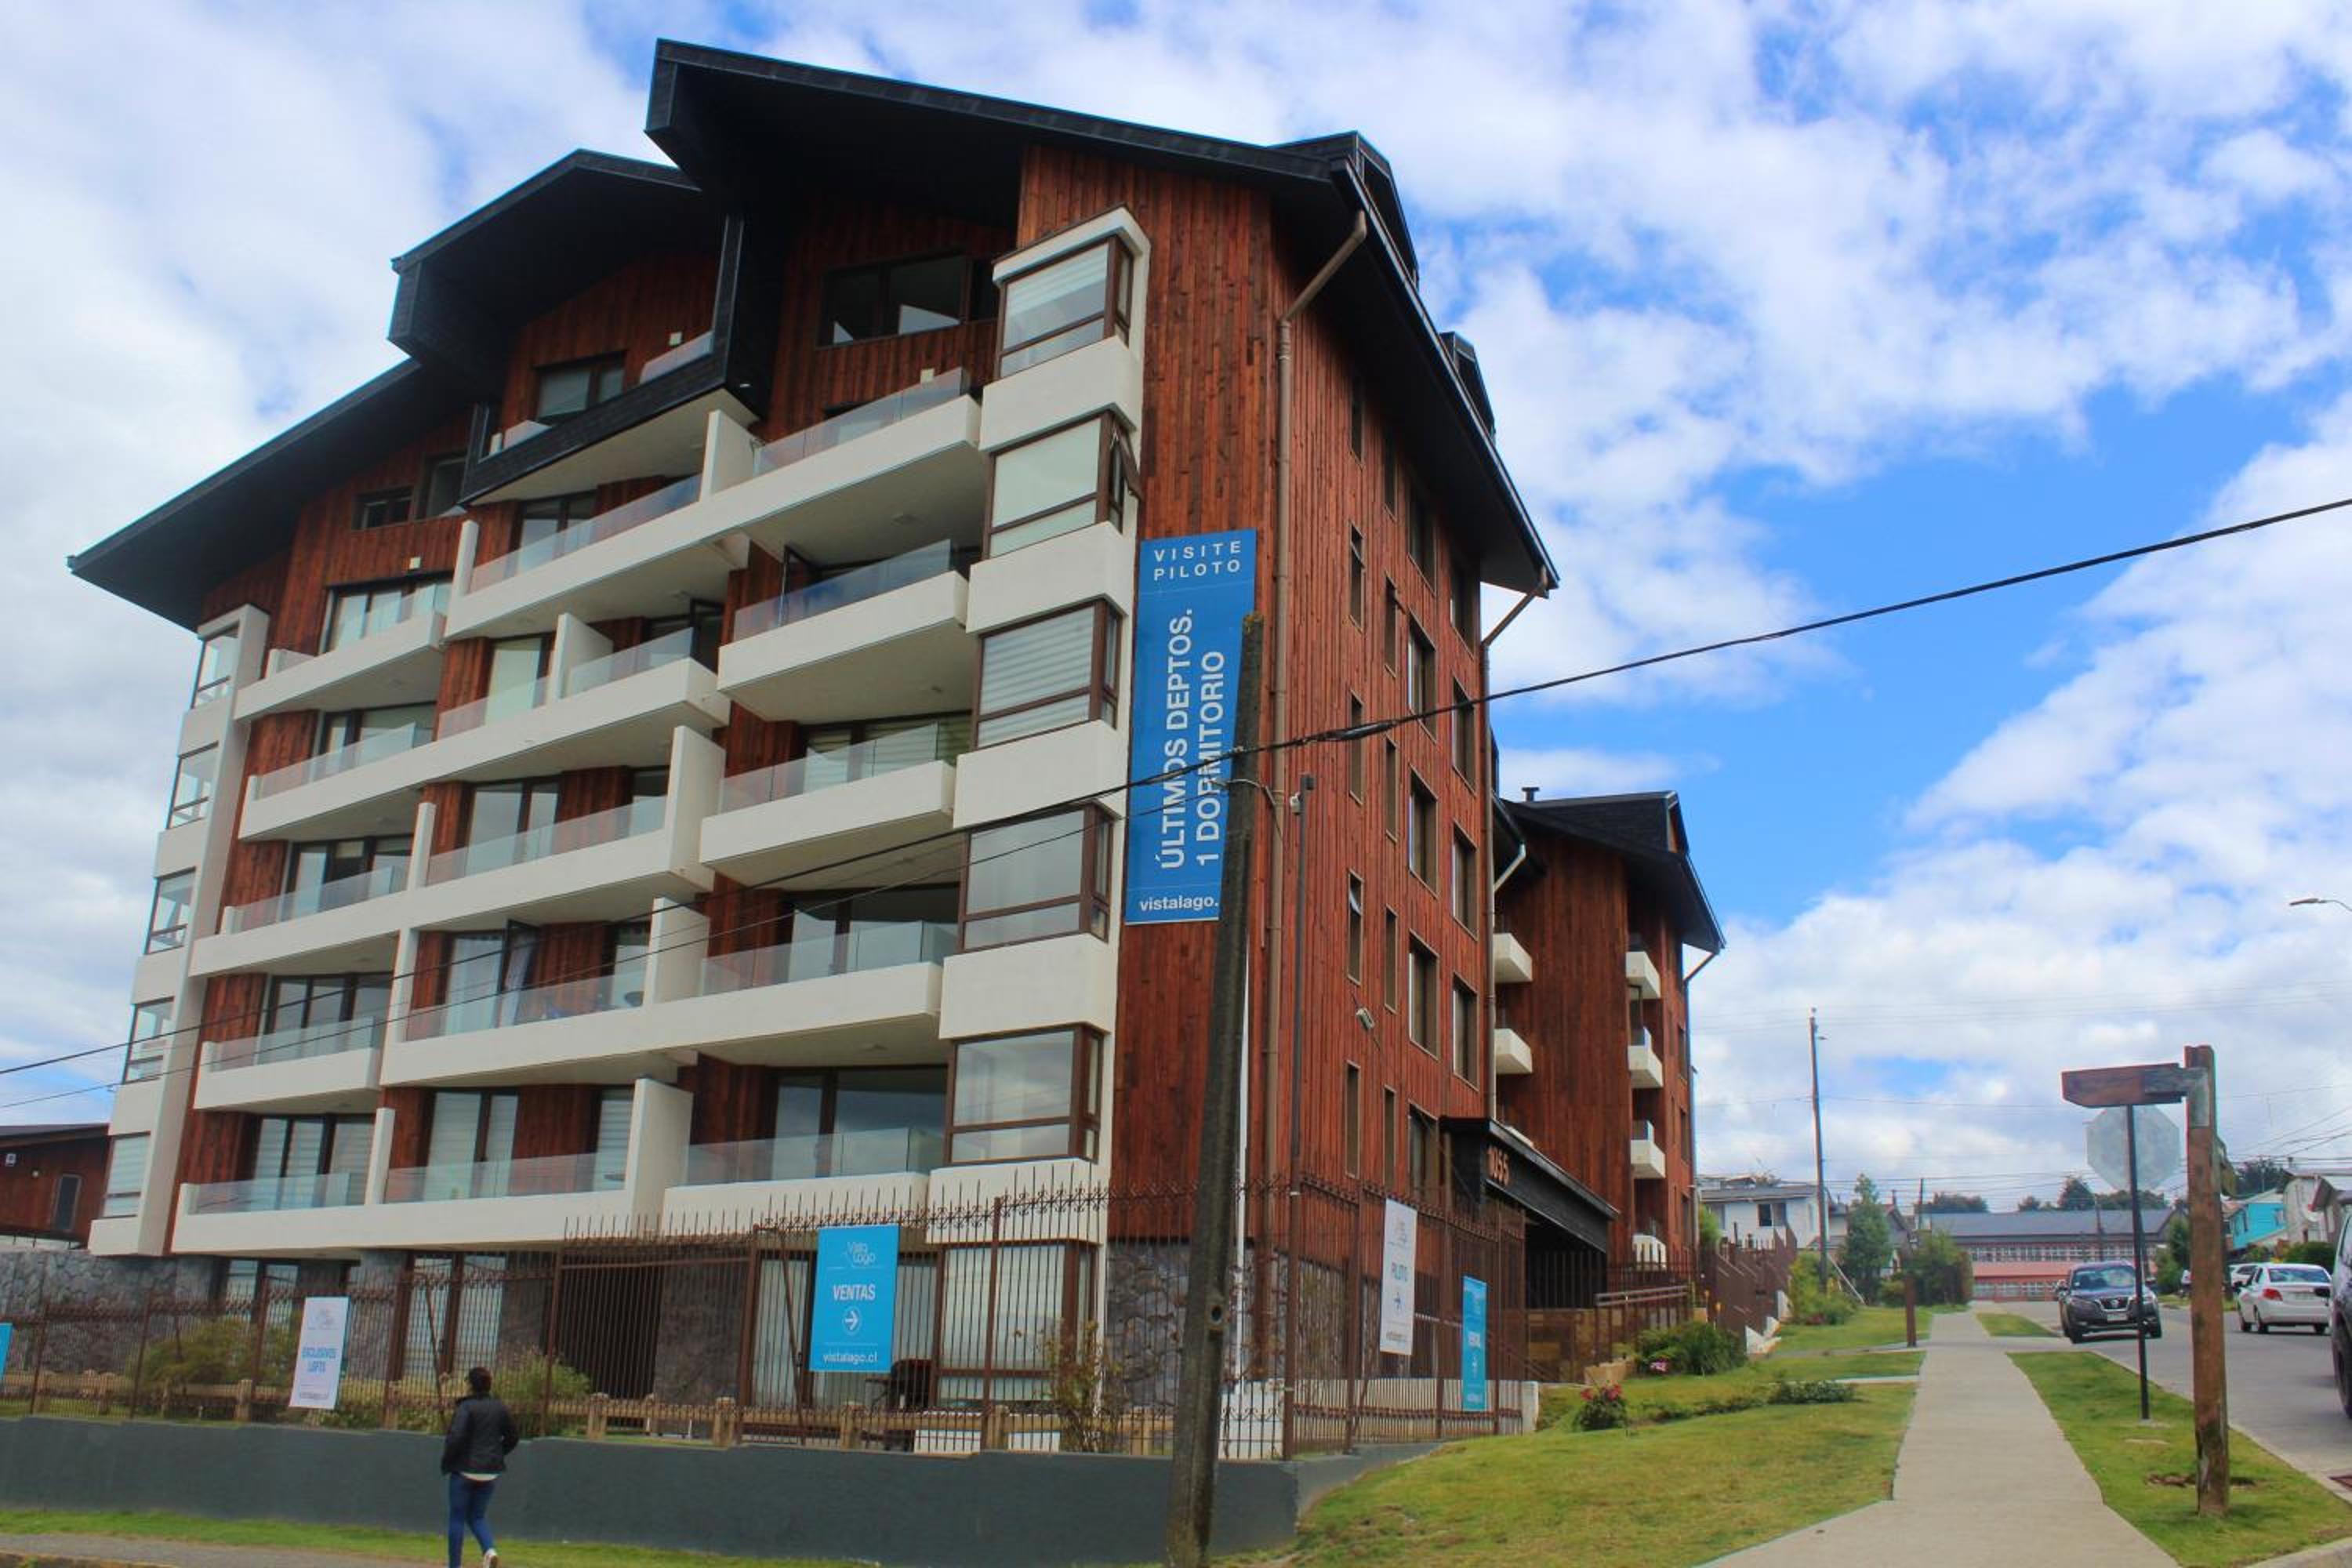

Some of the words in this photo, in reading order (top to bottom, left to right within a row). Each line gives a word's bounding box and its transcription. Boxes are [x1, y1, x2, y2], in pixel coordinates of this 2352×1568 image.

[1154, 540, 1241, 562] VISITE
[1154, 559, 1240, 581] PILOTO
[1167, 608, 1192, 730] DEPTOS.
[1196, 652, 1225, 840] DORMITORIO
[1155, 739, 1188, 869] ÚLTIMOS
[1196, 853, 1219, 866] 1
[833, 1283, 876, 1301] VENTAS
